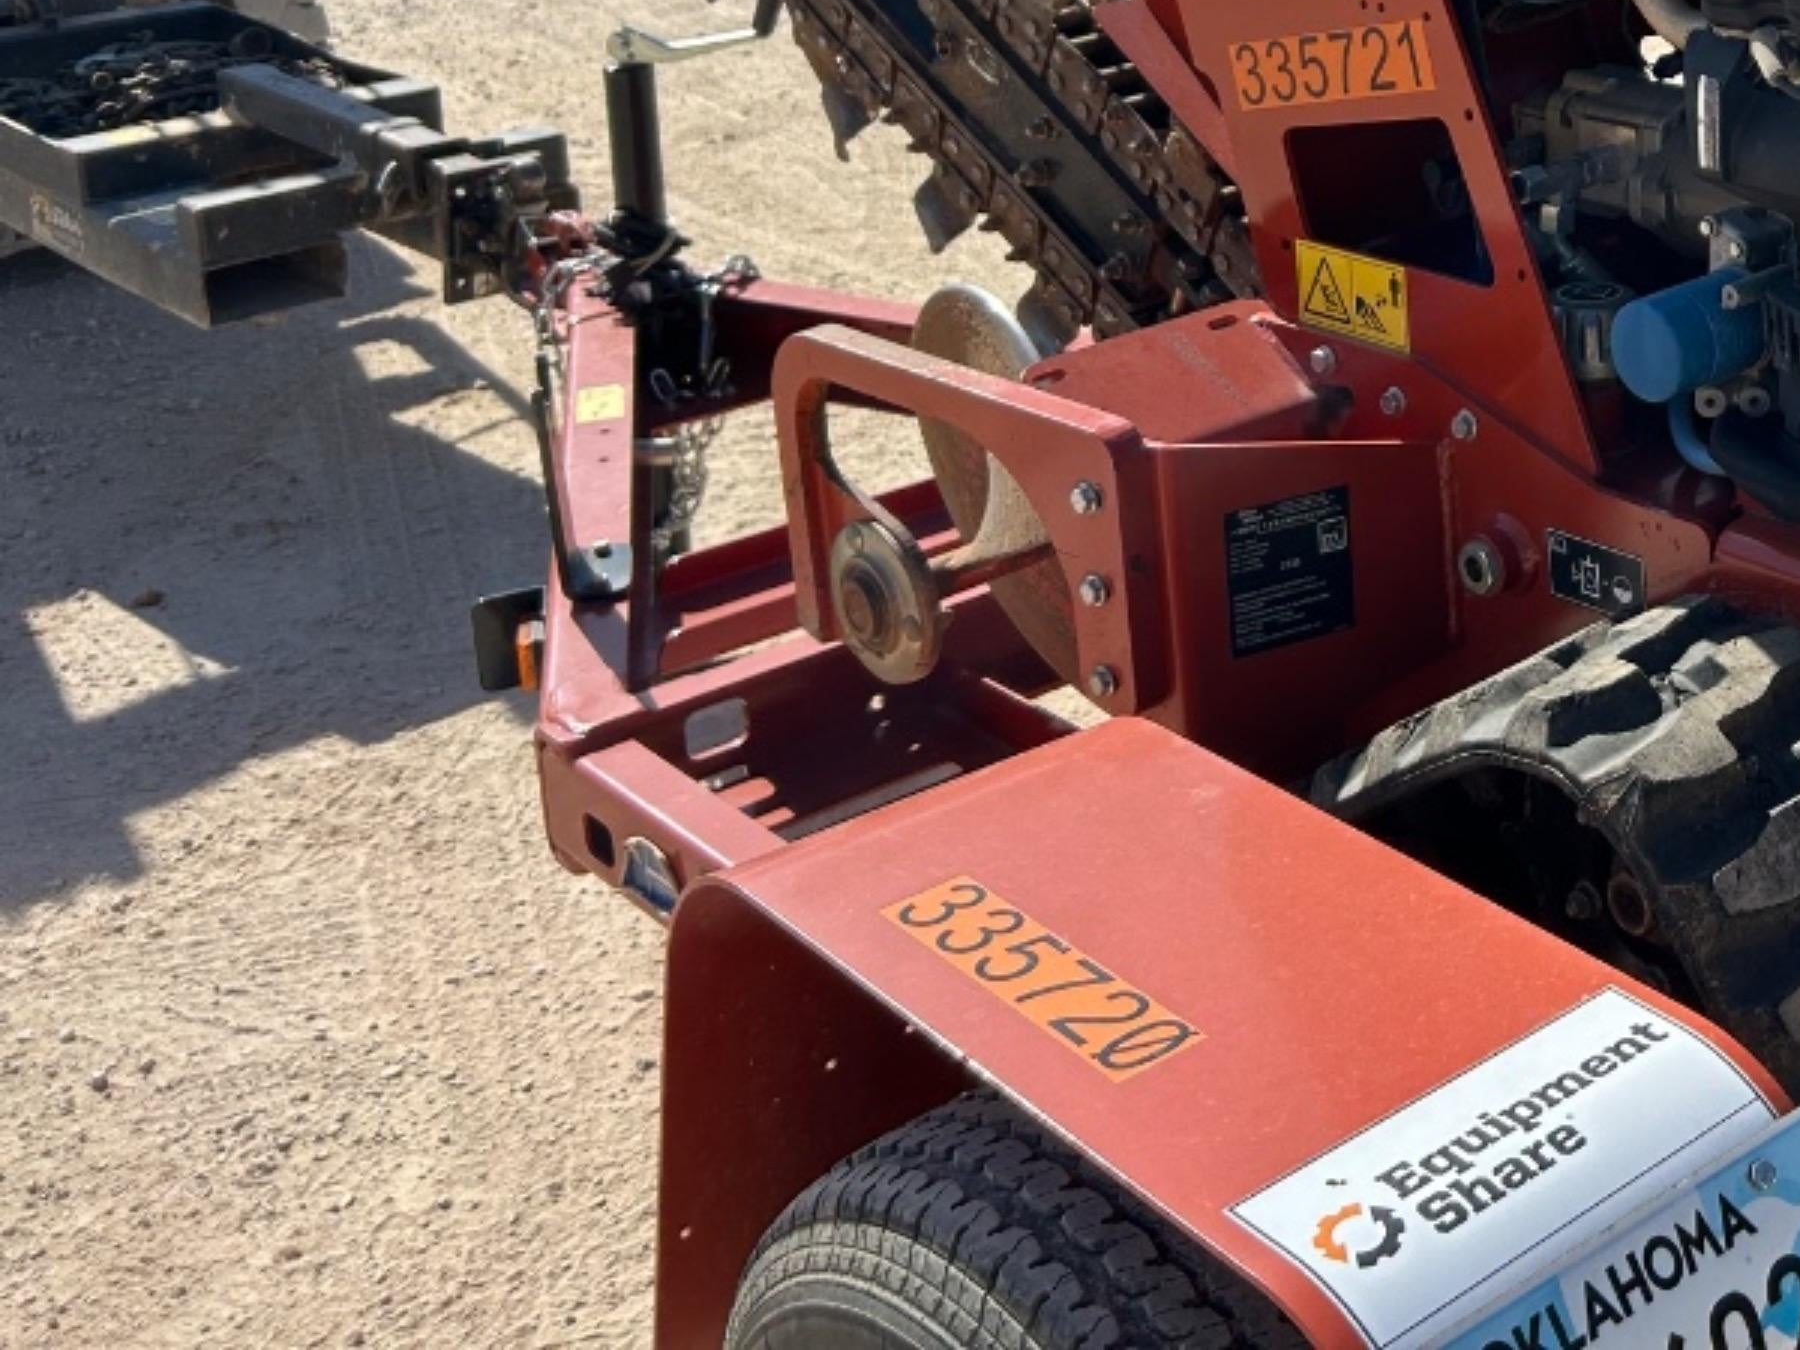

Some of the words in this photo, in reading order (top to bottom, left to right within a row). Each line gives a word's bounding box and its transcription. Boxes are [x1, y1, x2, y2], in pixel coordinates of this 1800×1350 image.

[1235, 22, 1423, 105] 335721
[899, 883, 1200, 1071] 335720
[1374, 1021, 1670, 1199] Equipment
[1415, 1123, 1588, 1234] Share
[1481, 1193, 1758, 1350] KLAHOMA
